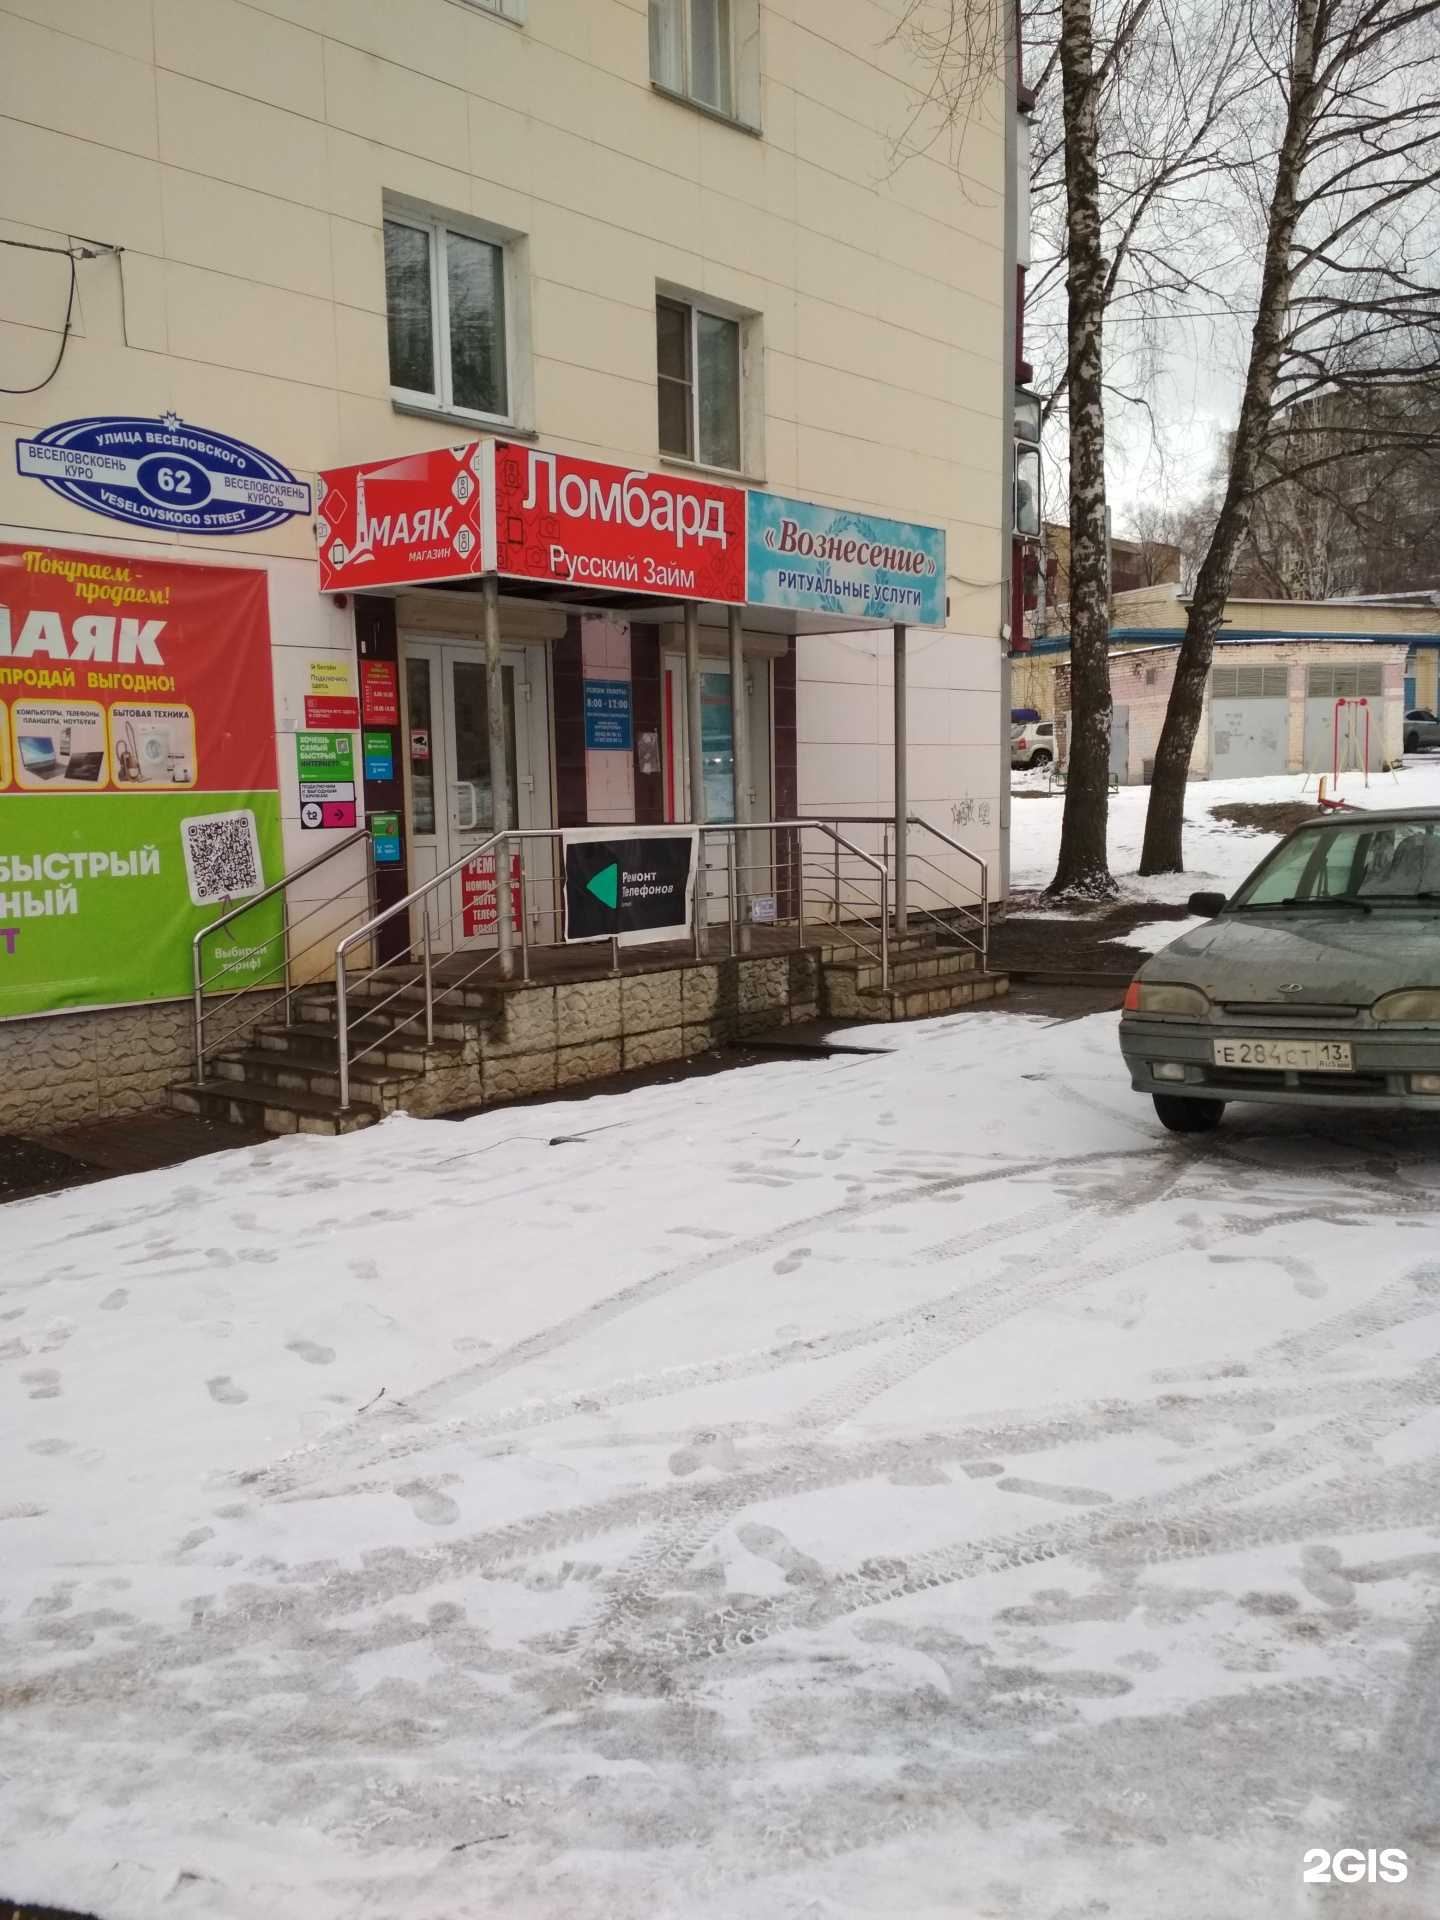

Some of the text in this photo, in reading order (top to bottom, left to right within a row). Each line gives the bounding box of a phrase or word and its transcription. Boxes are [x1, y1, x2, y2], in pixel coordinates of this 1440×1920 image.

[28, 446, 127, 471] ВЕСЕЛОВСКОЕНЬ
[96, 432, 247, 469] УЛИЦА ВЕСЕЛОВСКОГО
[64, 465, 94, 479] КУРО
[157, 467, 192, 494] 62
[224, 476, 305, 499] ВЕСЕЛОВСКЯЕНЬ
[247, 492, 285, 507] КУРОСЬ
[523, 450, 728, 550] Ломбард
[100, 488, 246, 527] VESELOVSKOGO STREET
[367, 506, 453, 546] МАЯК
[408, 546, 451, 562] МАГАЗИН
[764, 519, 936, 576] «Вознесение»
[22, 551, 133, 582] Покупаем
[550, 544, 696, 588] Русский Займ
[75, 582, 170, 606] продаем!
[778, 571, 922, 606] РИТУАЛЬНЫЕ УСЛУГИ
[0, 666, 175, 693] ПРОДАЙ ВЫГОДНО!
[113, 709, 189, 719] БЫТОВАЯ ТЕХНИКА
[468, 857, 515, 875] РЕМТ
[622, 871, 657, 883] Ремонт
[622, 884, 674, 898] Телефонов
[1321, 1044, 1342, 1060] 13
